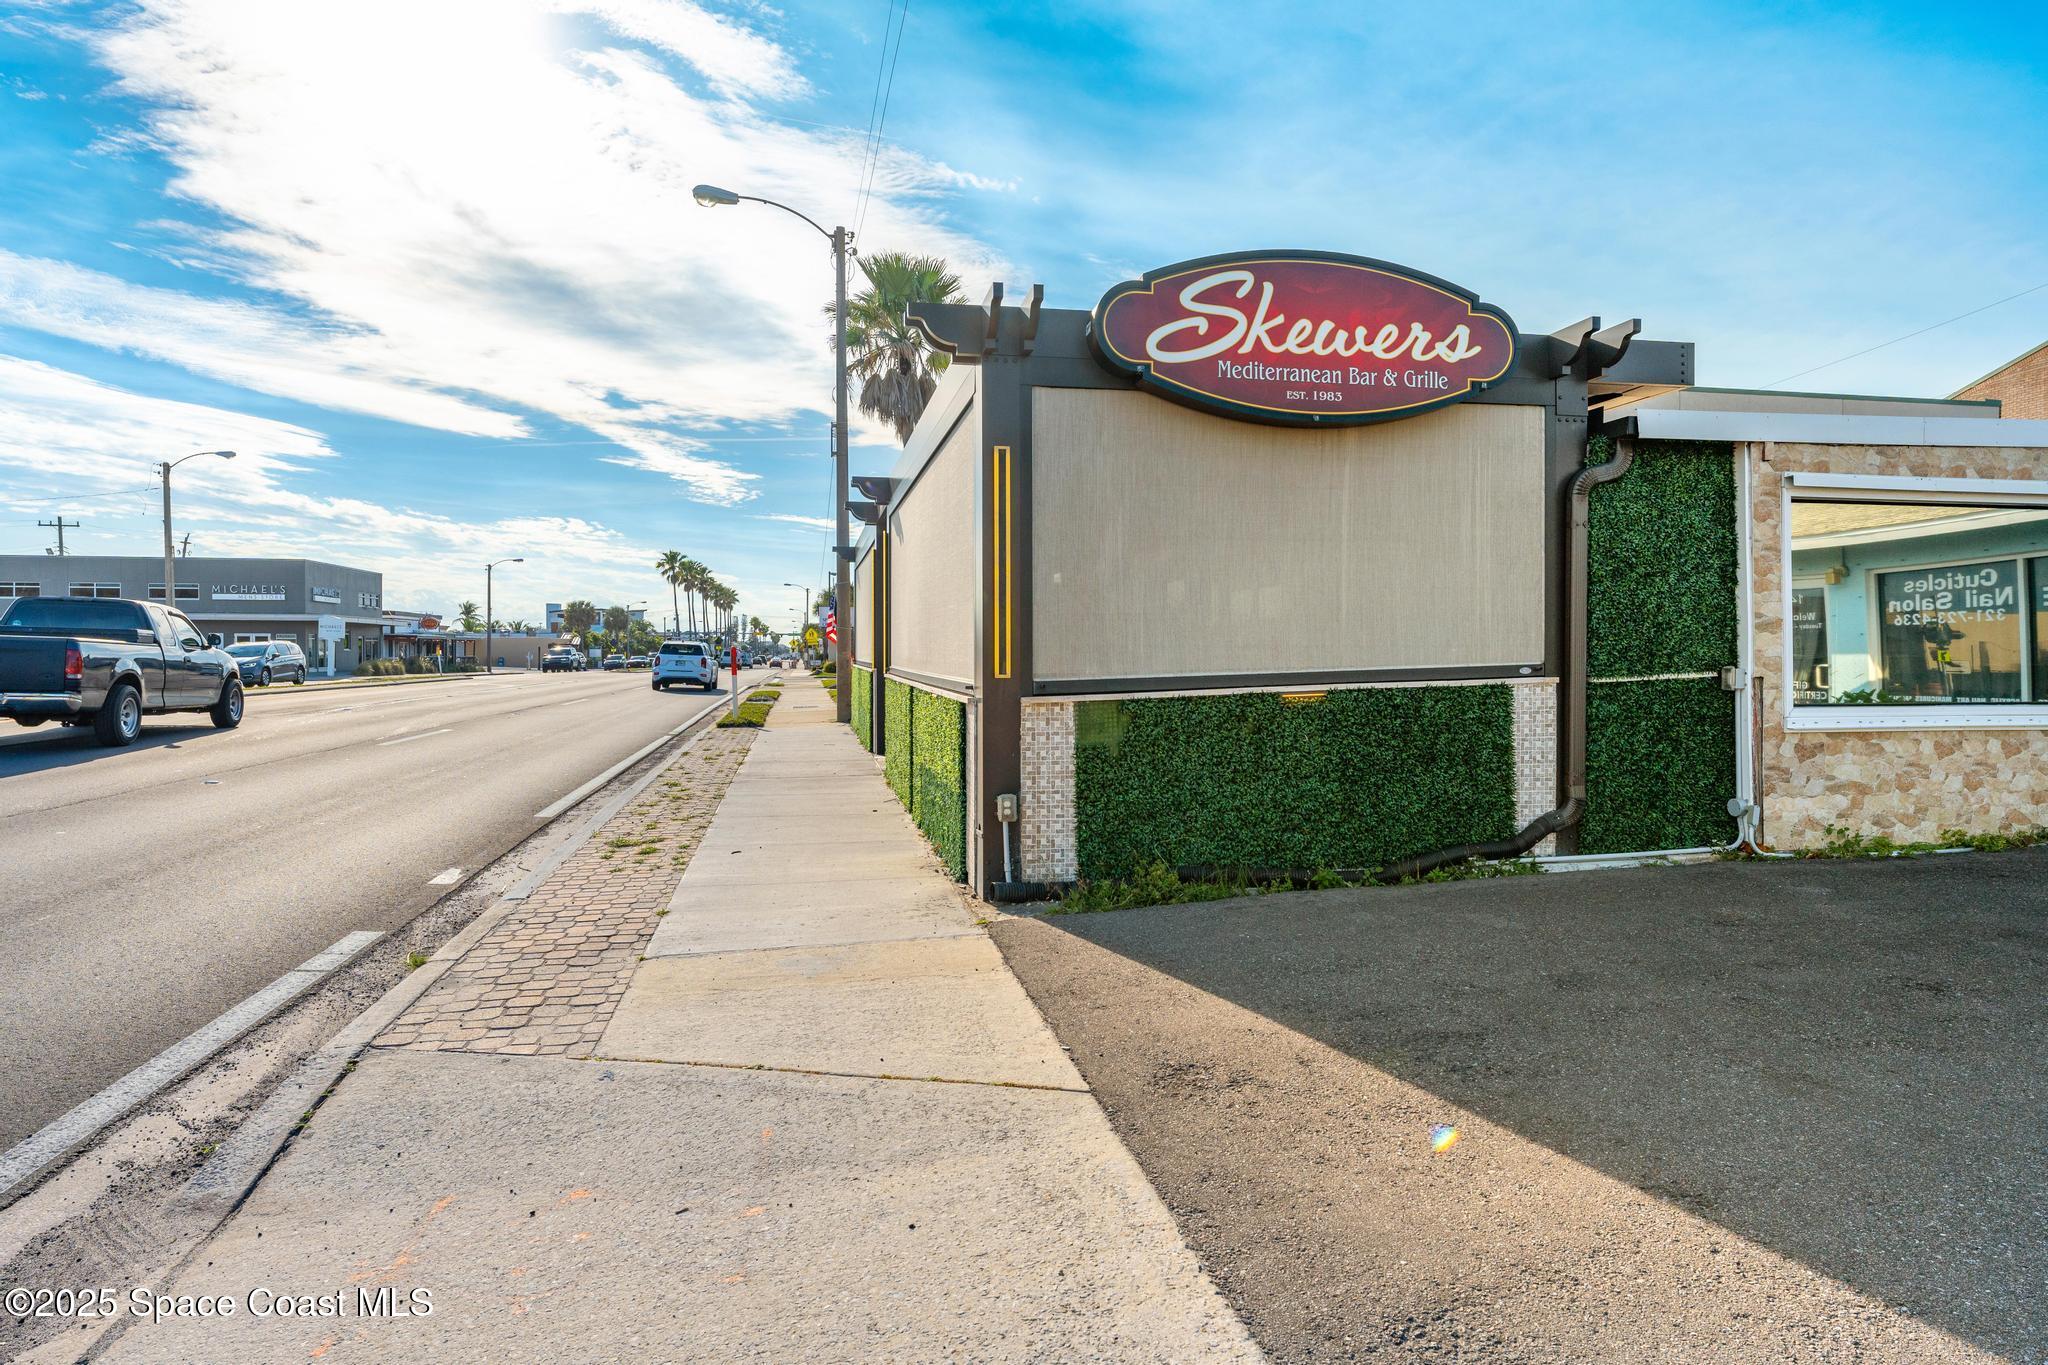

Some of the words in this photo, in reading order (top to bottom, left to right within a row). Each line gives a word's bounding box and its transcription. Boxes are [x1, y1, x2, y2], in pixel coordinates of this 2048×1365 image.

[1146, 270, 1481, 363] Skewers
[1218, 360, 1342, 384] Mediterranean
[1349, 368, 1377, 386] Bar
[1383, 368, 1398, 387] &
[1404, 370, 1448, 389] Grille
[1287, 390, 1308, 400] EST.
[1313, 391, 1342, 401] 1983
[211, 584, 286, 594] MICHAEL'S
